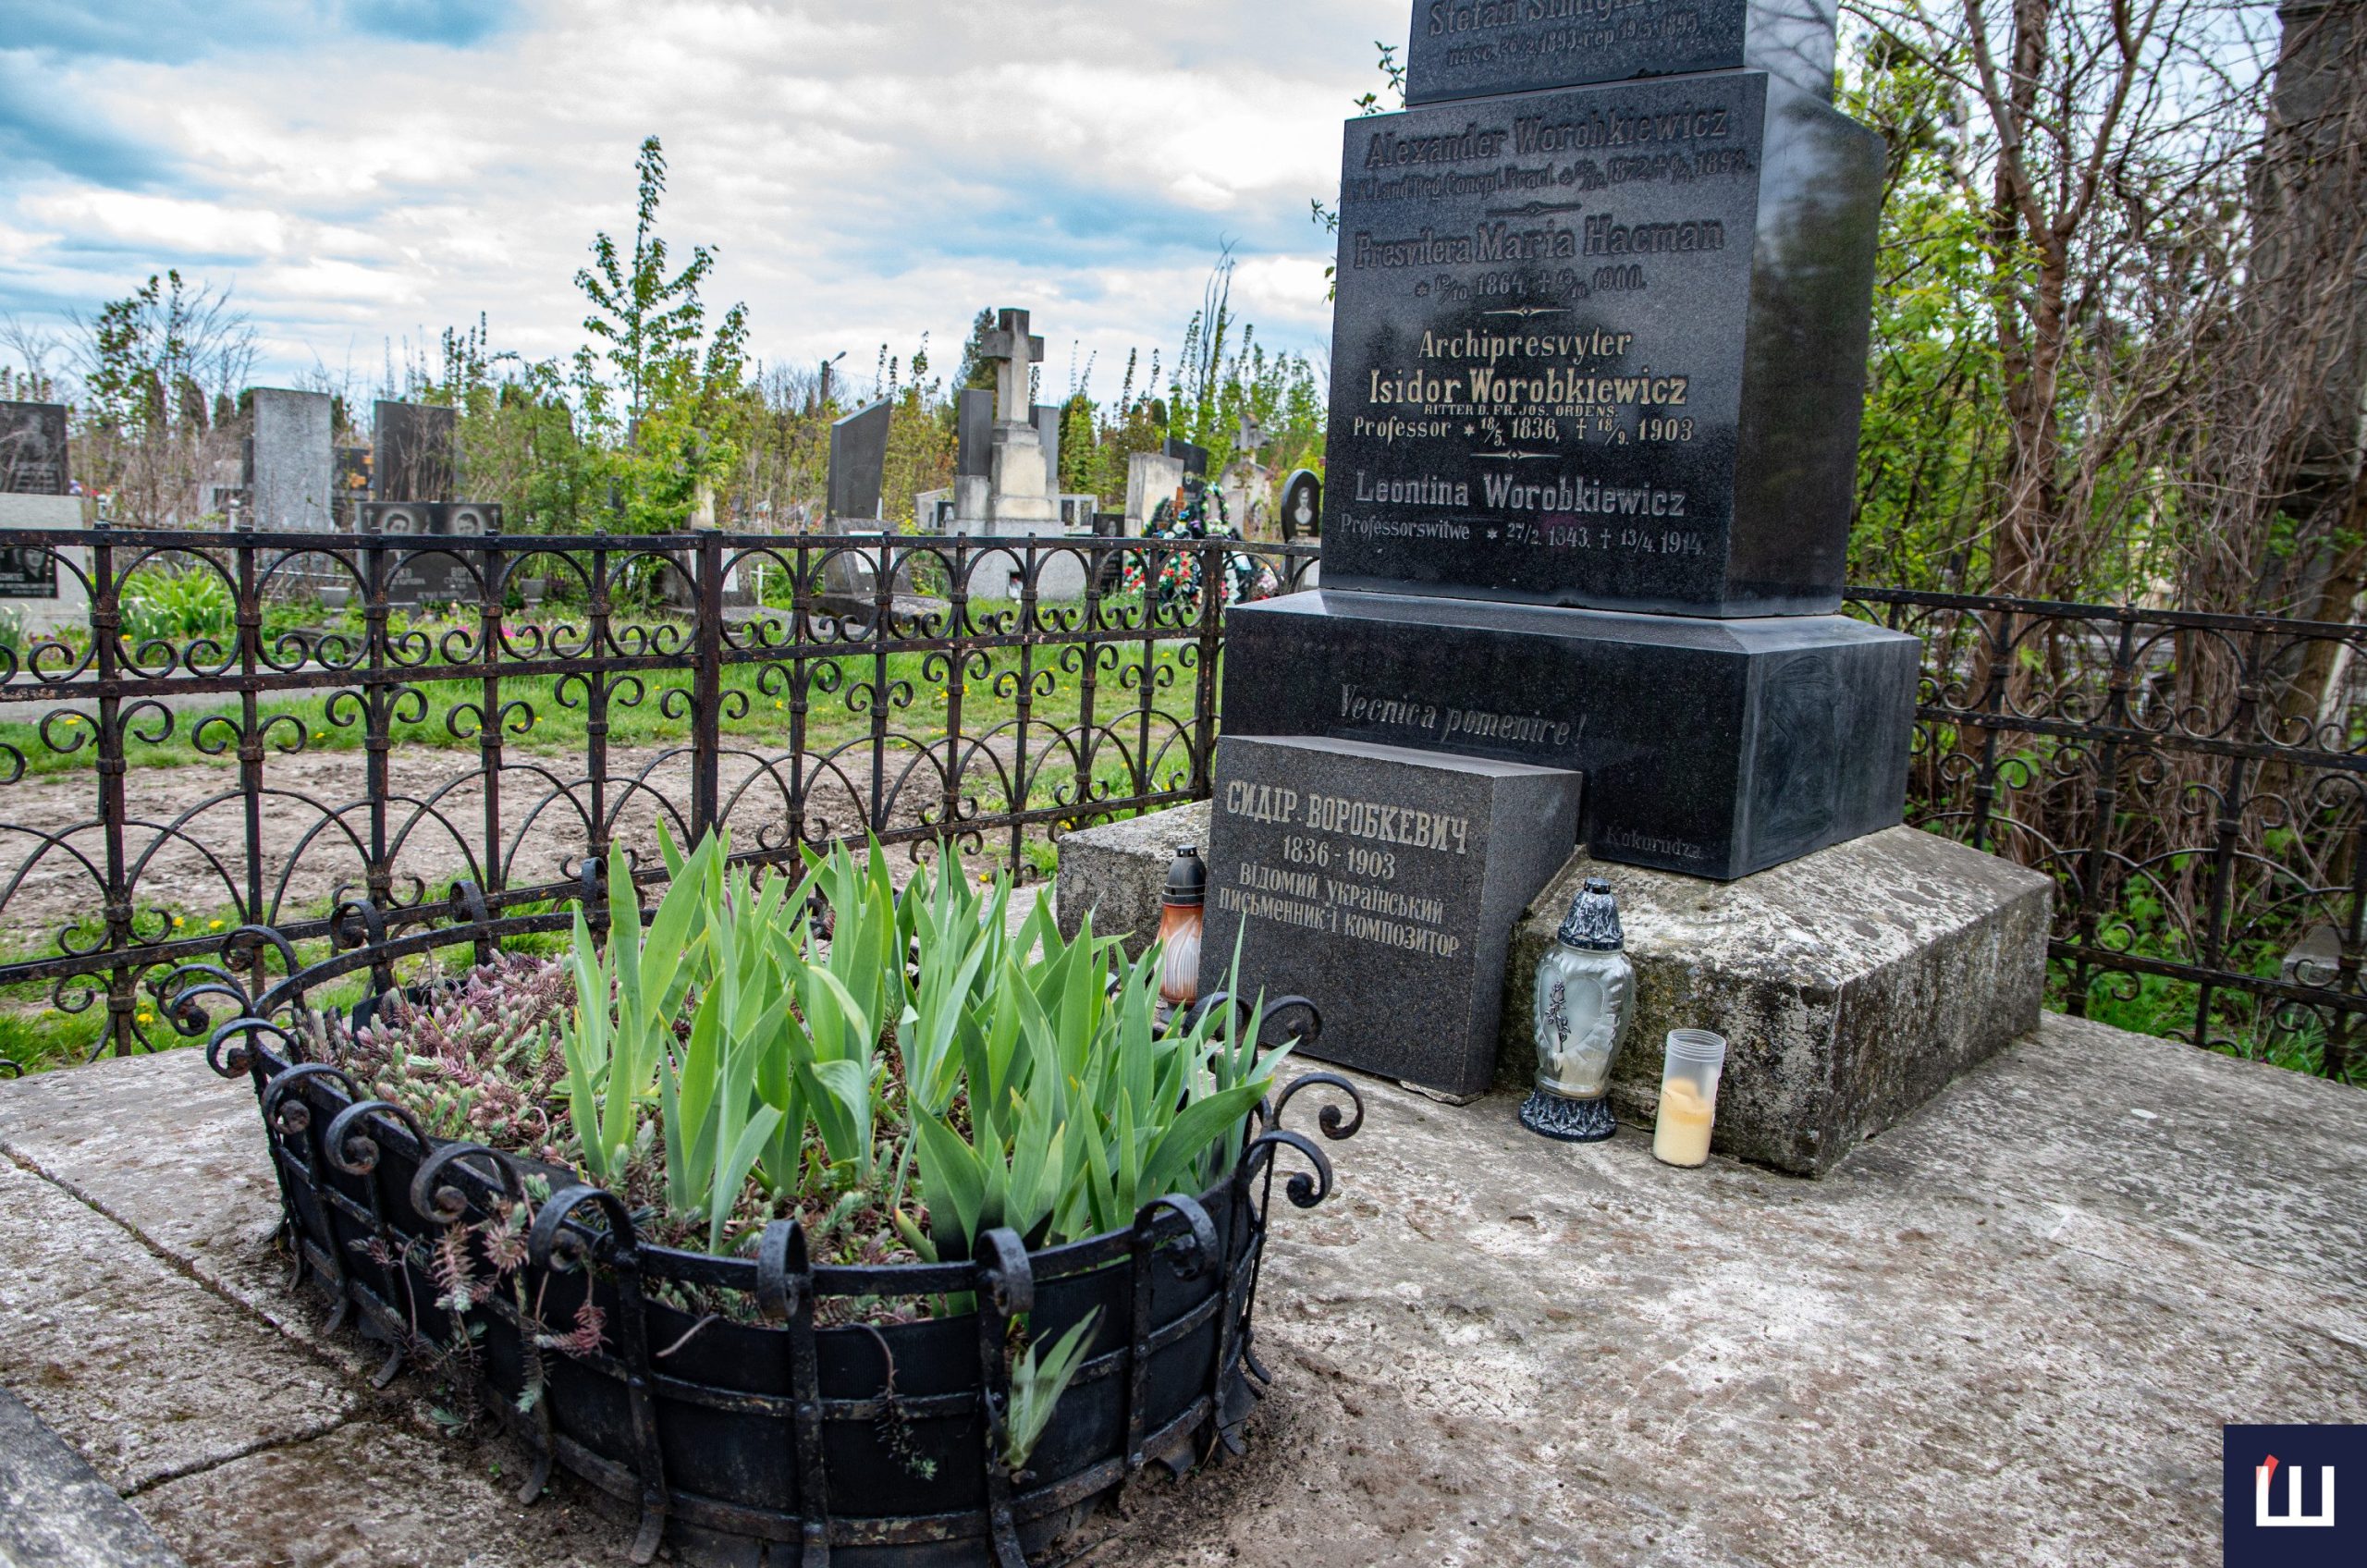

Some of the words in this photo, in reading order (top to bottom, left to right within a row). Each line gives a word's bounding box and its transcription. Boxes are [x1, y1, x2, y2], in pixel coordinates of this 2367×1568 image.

[1429, 0, 1517, 36] Stefan
[1365, 122, 1508, 168] Alexander
[1515, 101, 1729, 153] Worobkiewicz
[1354, 226, 1471, 269] Presvitera
[1478, 218, 1574, 261] Maria
[1584, 213, 1724, 256] Hacman
[1417, 326, 1633, 365] Archipresvyter
[1369, 368, 1462, 404] Isidor
[1468, 366, 1689, 405] Worobkiewicz
[1353, 415, 1452, 445] Professor
[1638, 417, 1695, 442] 1903
[1424, 404, 1474, 416] RITTER
[1477, 405, 1490, 417] D.
[1555, 405, 1620, 418] ORDENS.
[1355, 468, 1470, 507] Leontina
[1482, 472, 1686, 518] Worobkiewicz
[1340, 512, 1471, 541] Professorswitwe
[1340, 683, 1437, 729] Vecnica
[1226, 778, 1298, 825] СИДІР
[1306, 793, 1470, 855] ВОРОБКЕВИЧ
[1282, 834, 1331, 868] 1836
[1346, 846, 1397, 881] 1903
[1218, 887, 1327, 931] письменник
[1343, 913, 1470, 959] композитор
